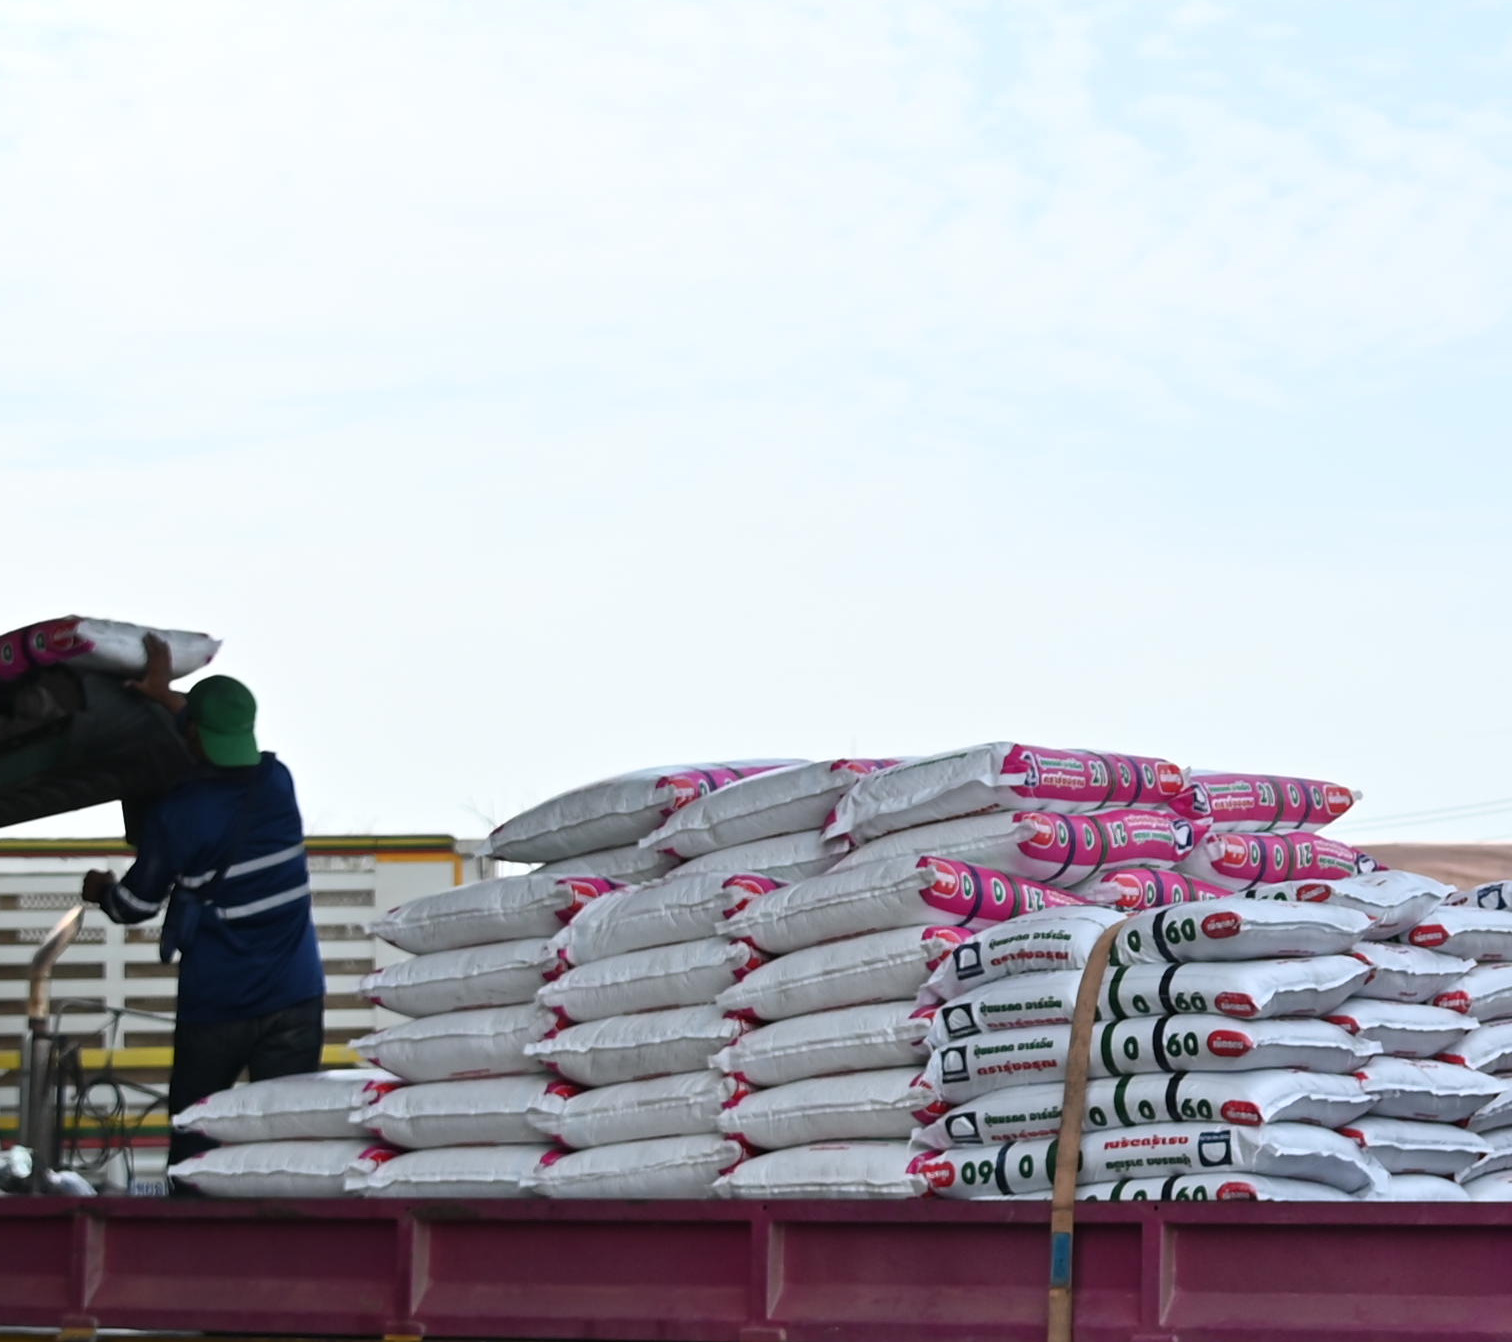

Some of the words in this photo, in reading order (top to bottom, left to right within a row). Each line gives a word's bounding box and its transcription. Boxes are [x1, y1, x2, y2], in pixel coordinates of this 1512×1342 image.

[1089, 761, 1108, 787] 21
[1120, 762, 1131, 787] 0
[1143, 763, 1156, 788] 0
[1256, 781, 1276, 806] 21
[1288, 784, 1300, 807] 0
[1311, 785, 1323, 809] 0
[1056, 820, 1069, 847] 0
[1249, 841, 1261, 867] 0
[1273, 844, 1284, 870] 0
[961, 871, 975, 900] 0
[991, 877, 1007, 905] 0
[1146, 880, 1157, 907] 0
[1127, 930, 1142, 953] 0
[1165, 917, 1197, 945] 60
[1132, 994, 1150, 1013] 0
[1175, 991, 1208, 1012] 60
[1123, 1036, 1139, 1060] 0
[1166, 1031, 1199, 1058] 60
[1089, 1106, 1108, 1126] 0
[1139, 1099, 1156, 1119] 0
[1181, 1098, 1213, 1119] 60
[1019, 1154, 1034, 1179] 0
